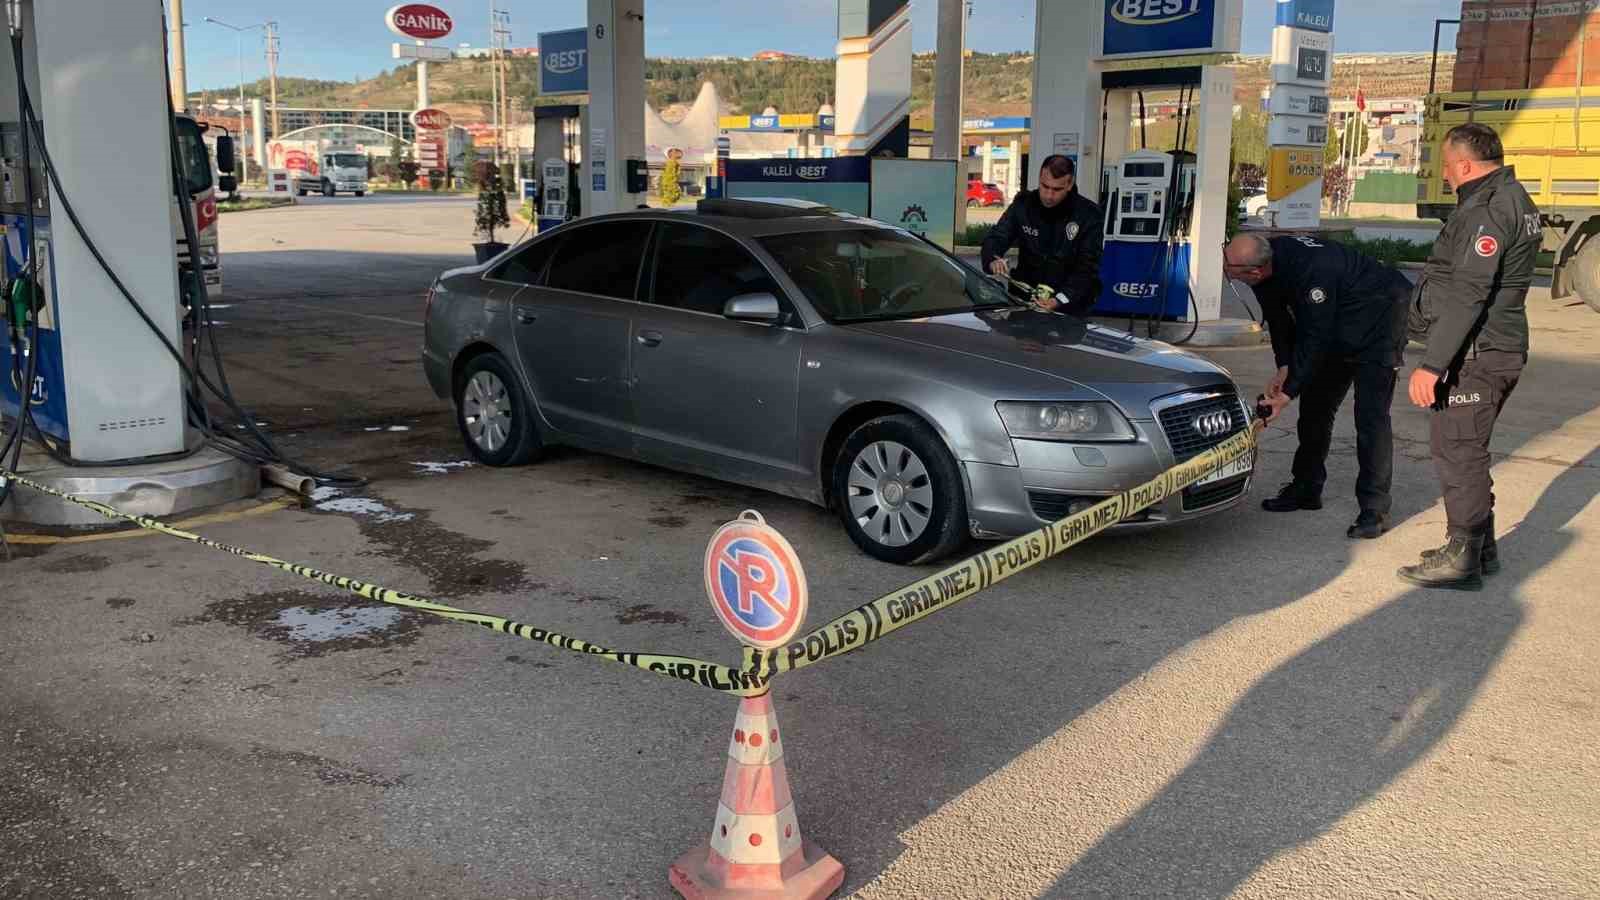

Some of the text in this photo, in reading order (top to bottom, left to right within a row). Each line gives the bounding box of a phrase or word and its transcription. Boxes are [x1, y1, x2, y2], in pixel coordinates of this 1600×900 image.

[395, 13, 449, 31] GANİK
[550, 49, 587, 69] BEST
[799, 165, 828, 178] BEST
[1119, 282, 1159, 296] BEST
[1448, 392, 1480, 406] POLIS
